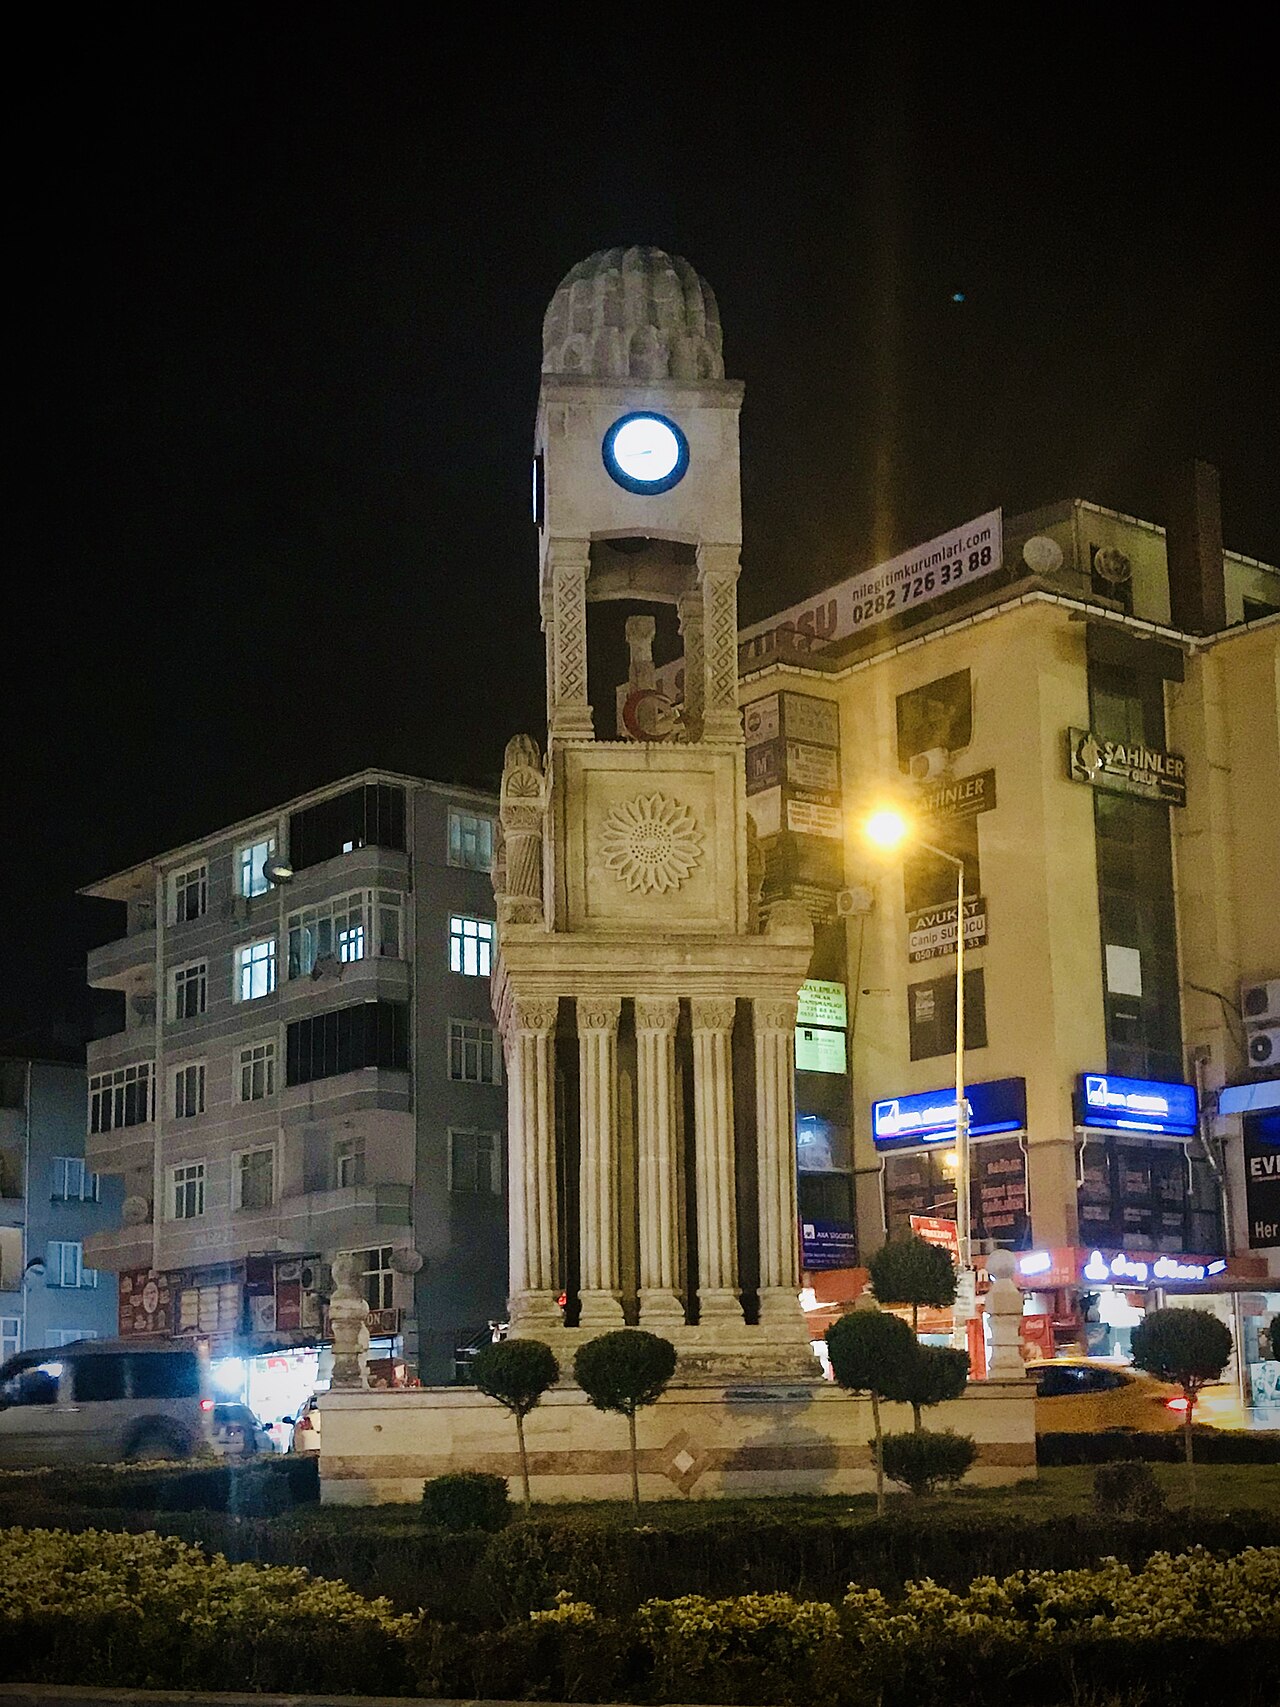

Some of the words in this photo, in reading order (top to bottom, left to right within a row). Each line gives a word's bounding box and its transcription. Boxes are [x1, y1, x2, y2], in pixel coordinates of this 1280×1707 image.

[852, 589, 896, 624] 0282
[901, 571, 936, 603] 726
[940, 559, 964, 585] 33
[968, 546, 992, 572] 88
[1255, 1220, 1279, 1239] Her
